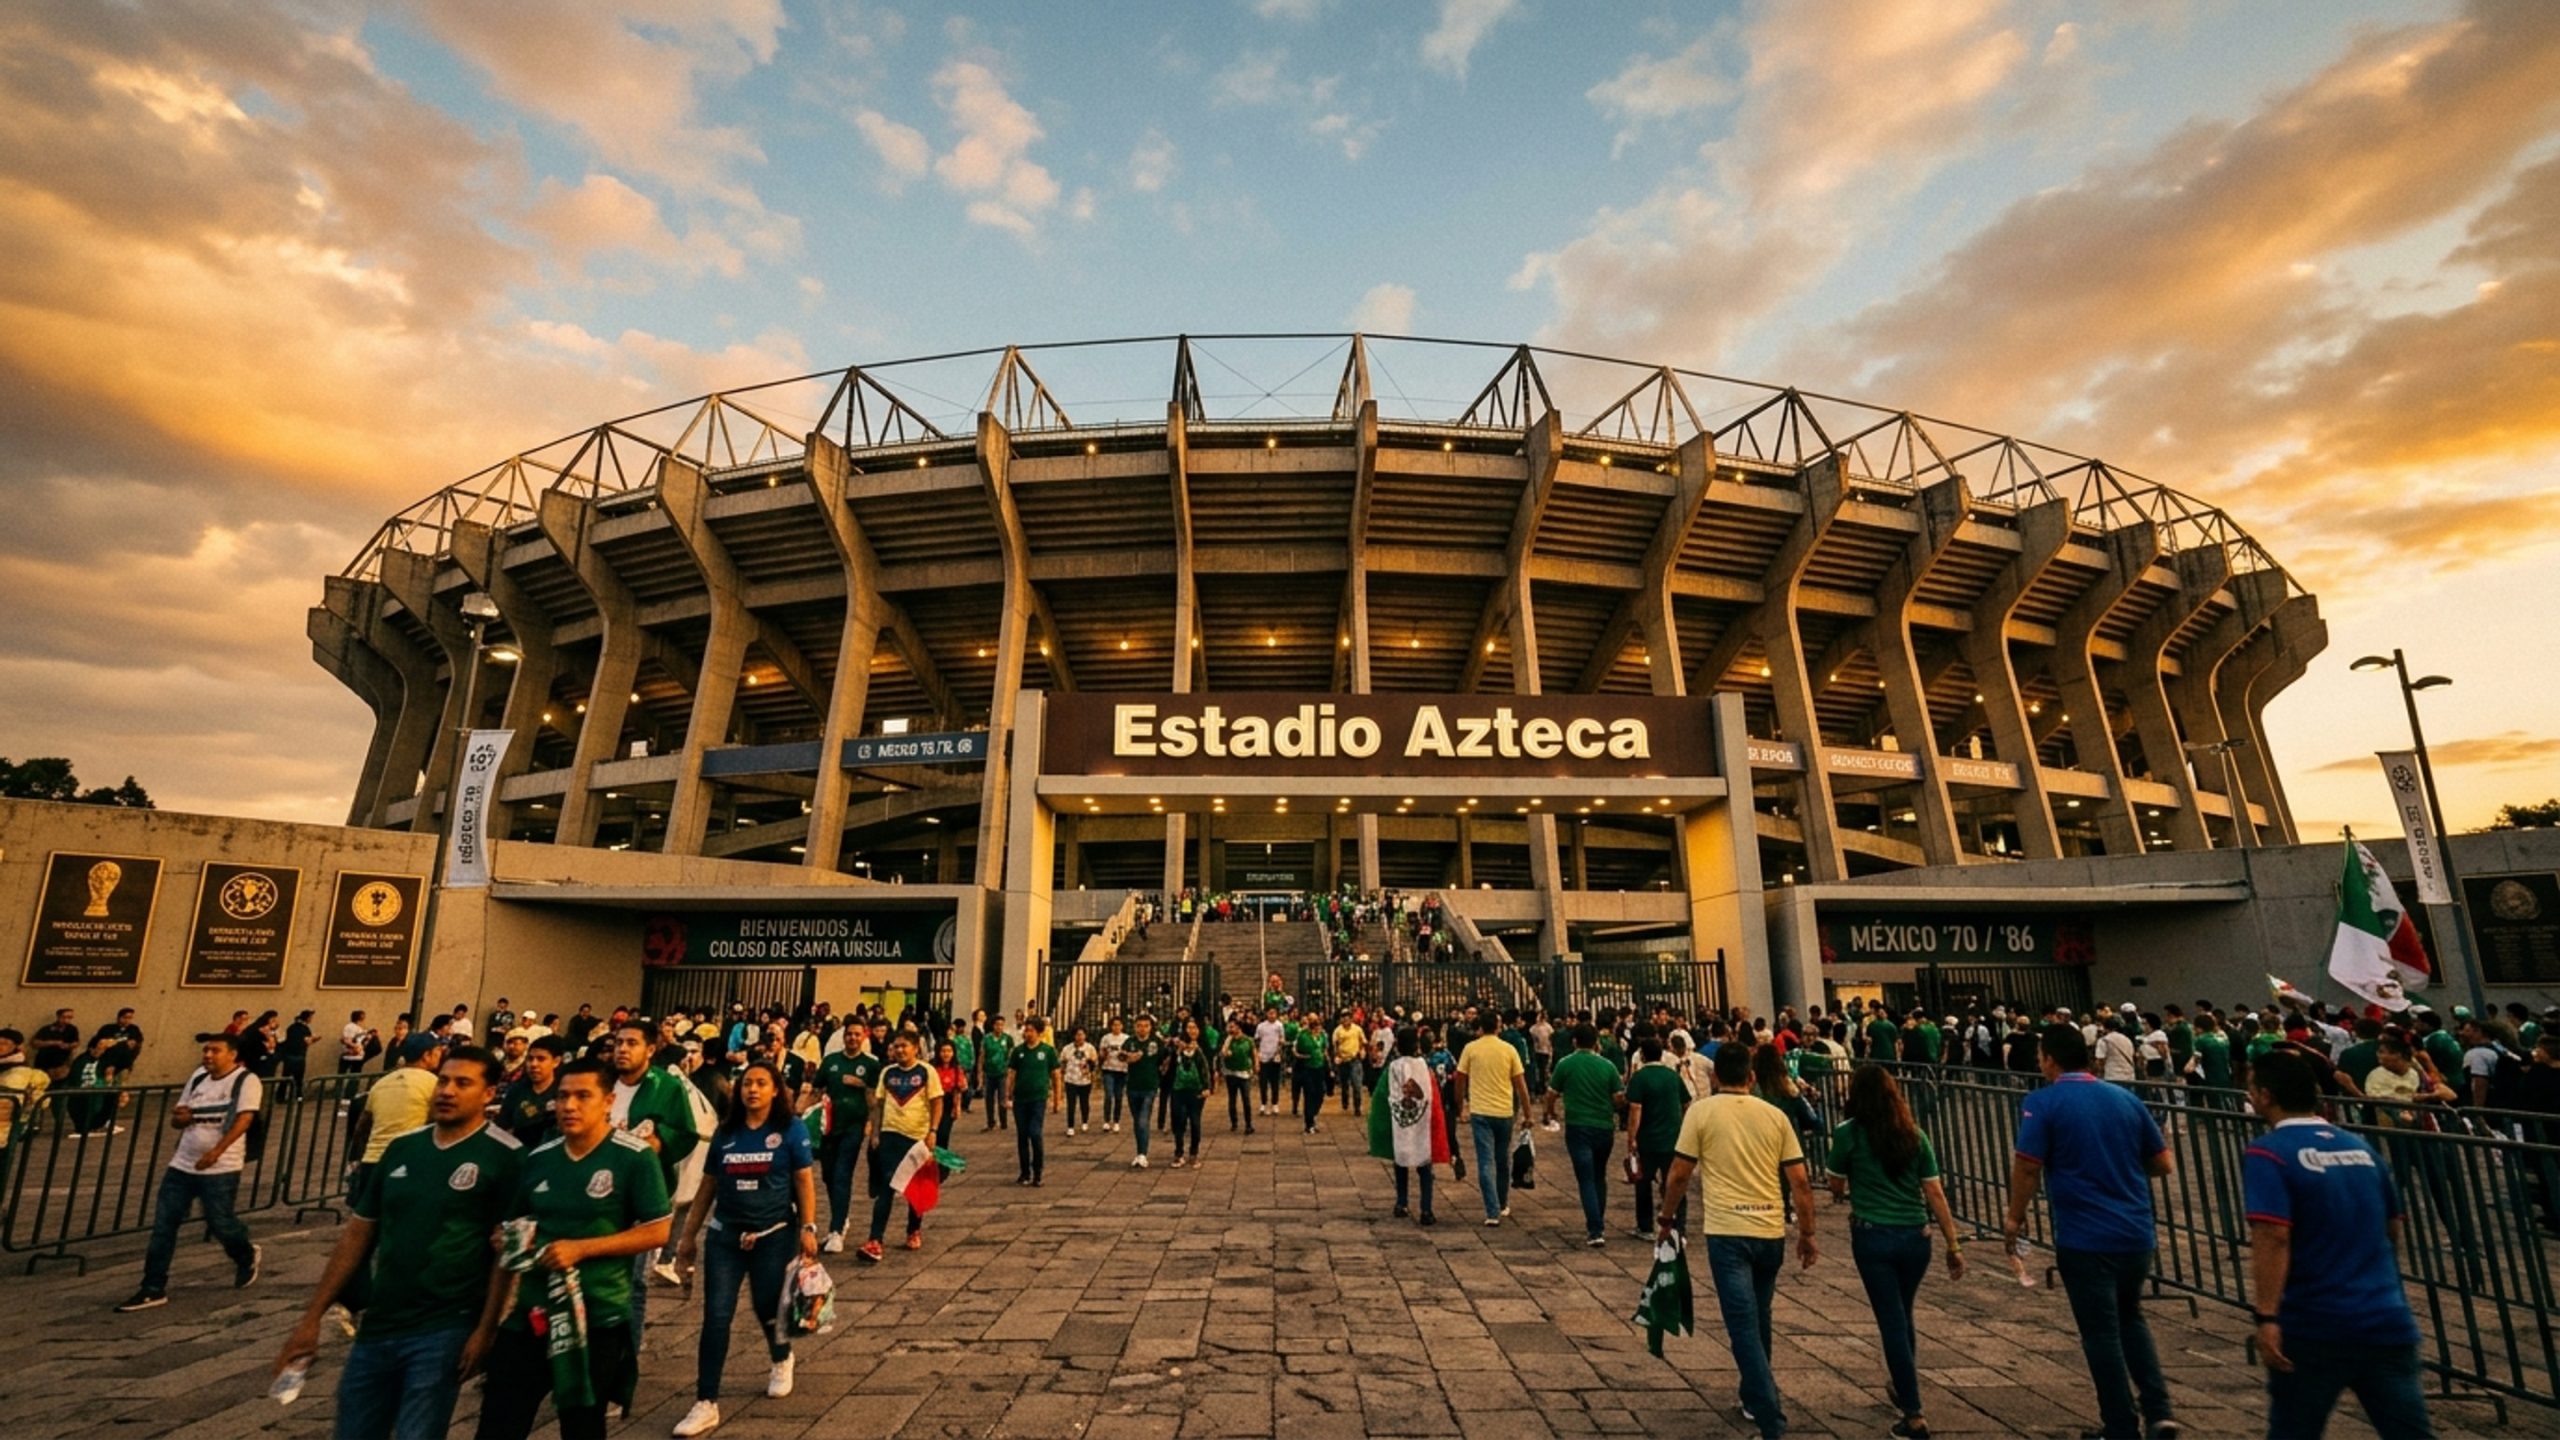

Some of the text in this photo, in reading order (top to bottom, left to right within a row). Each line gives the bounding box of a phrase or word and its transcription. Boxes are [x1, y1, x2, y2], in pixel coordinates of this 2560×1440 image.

[1114, 703, 1651, 759] Estadio Azteca
[740, 919, 873, 937] BIENVENIDOS AL
[1851, 919, 2035, 952] MÉXICO '70 / '86
[709, 940, 766, 958] COLOSO
[770, 940, 789, 958] DE
[792, 940, 840, 958] SANTA
